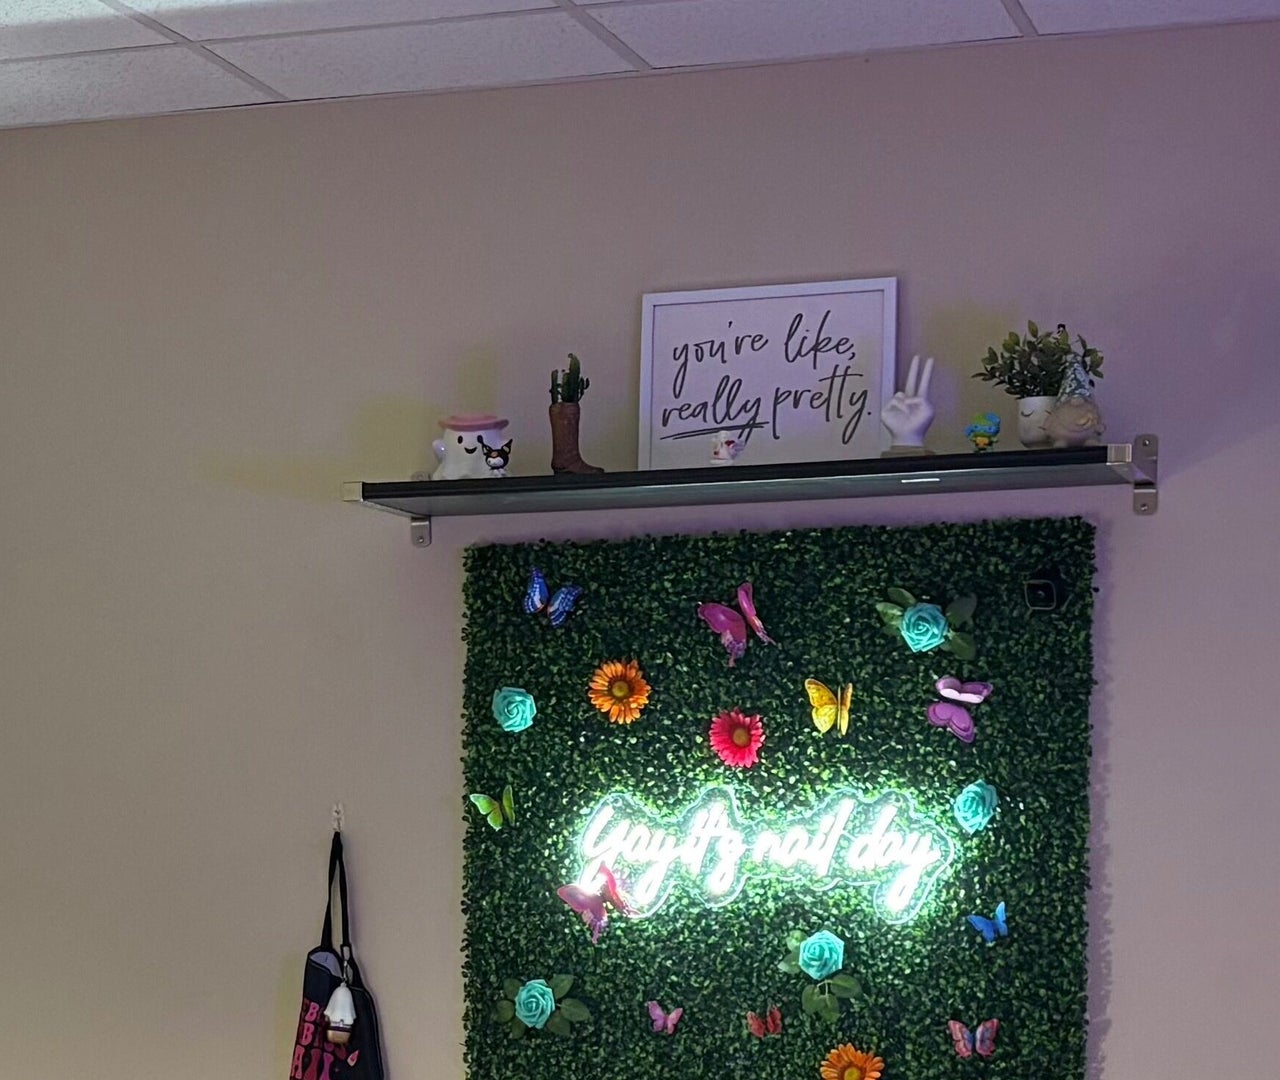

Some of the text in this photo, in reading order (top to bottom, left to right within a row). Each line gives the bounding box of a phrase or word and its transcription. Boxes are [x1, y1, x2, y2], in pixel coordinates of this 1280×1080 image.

[673, 321, 768, 399] you're
[661, 375, 763, 444] really
[751, 798, 855, 878] nail
[847, 804, 942, 912] day
